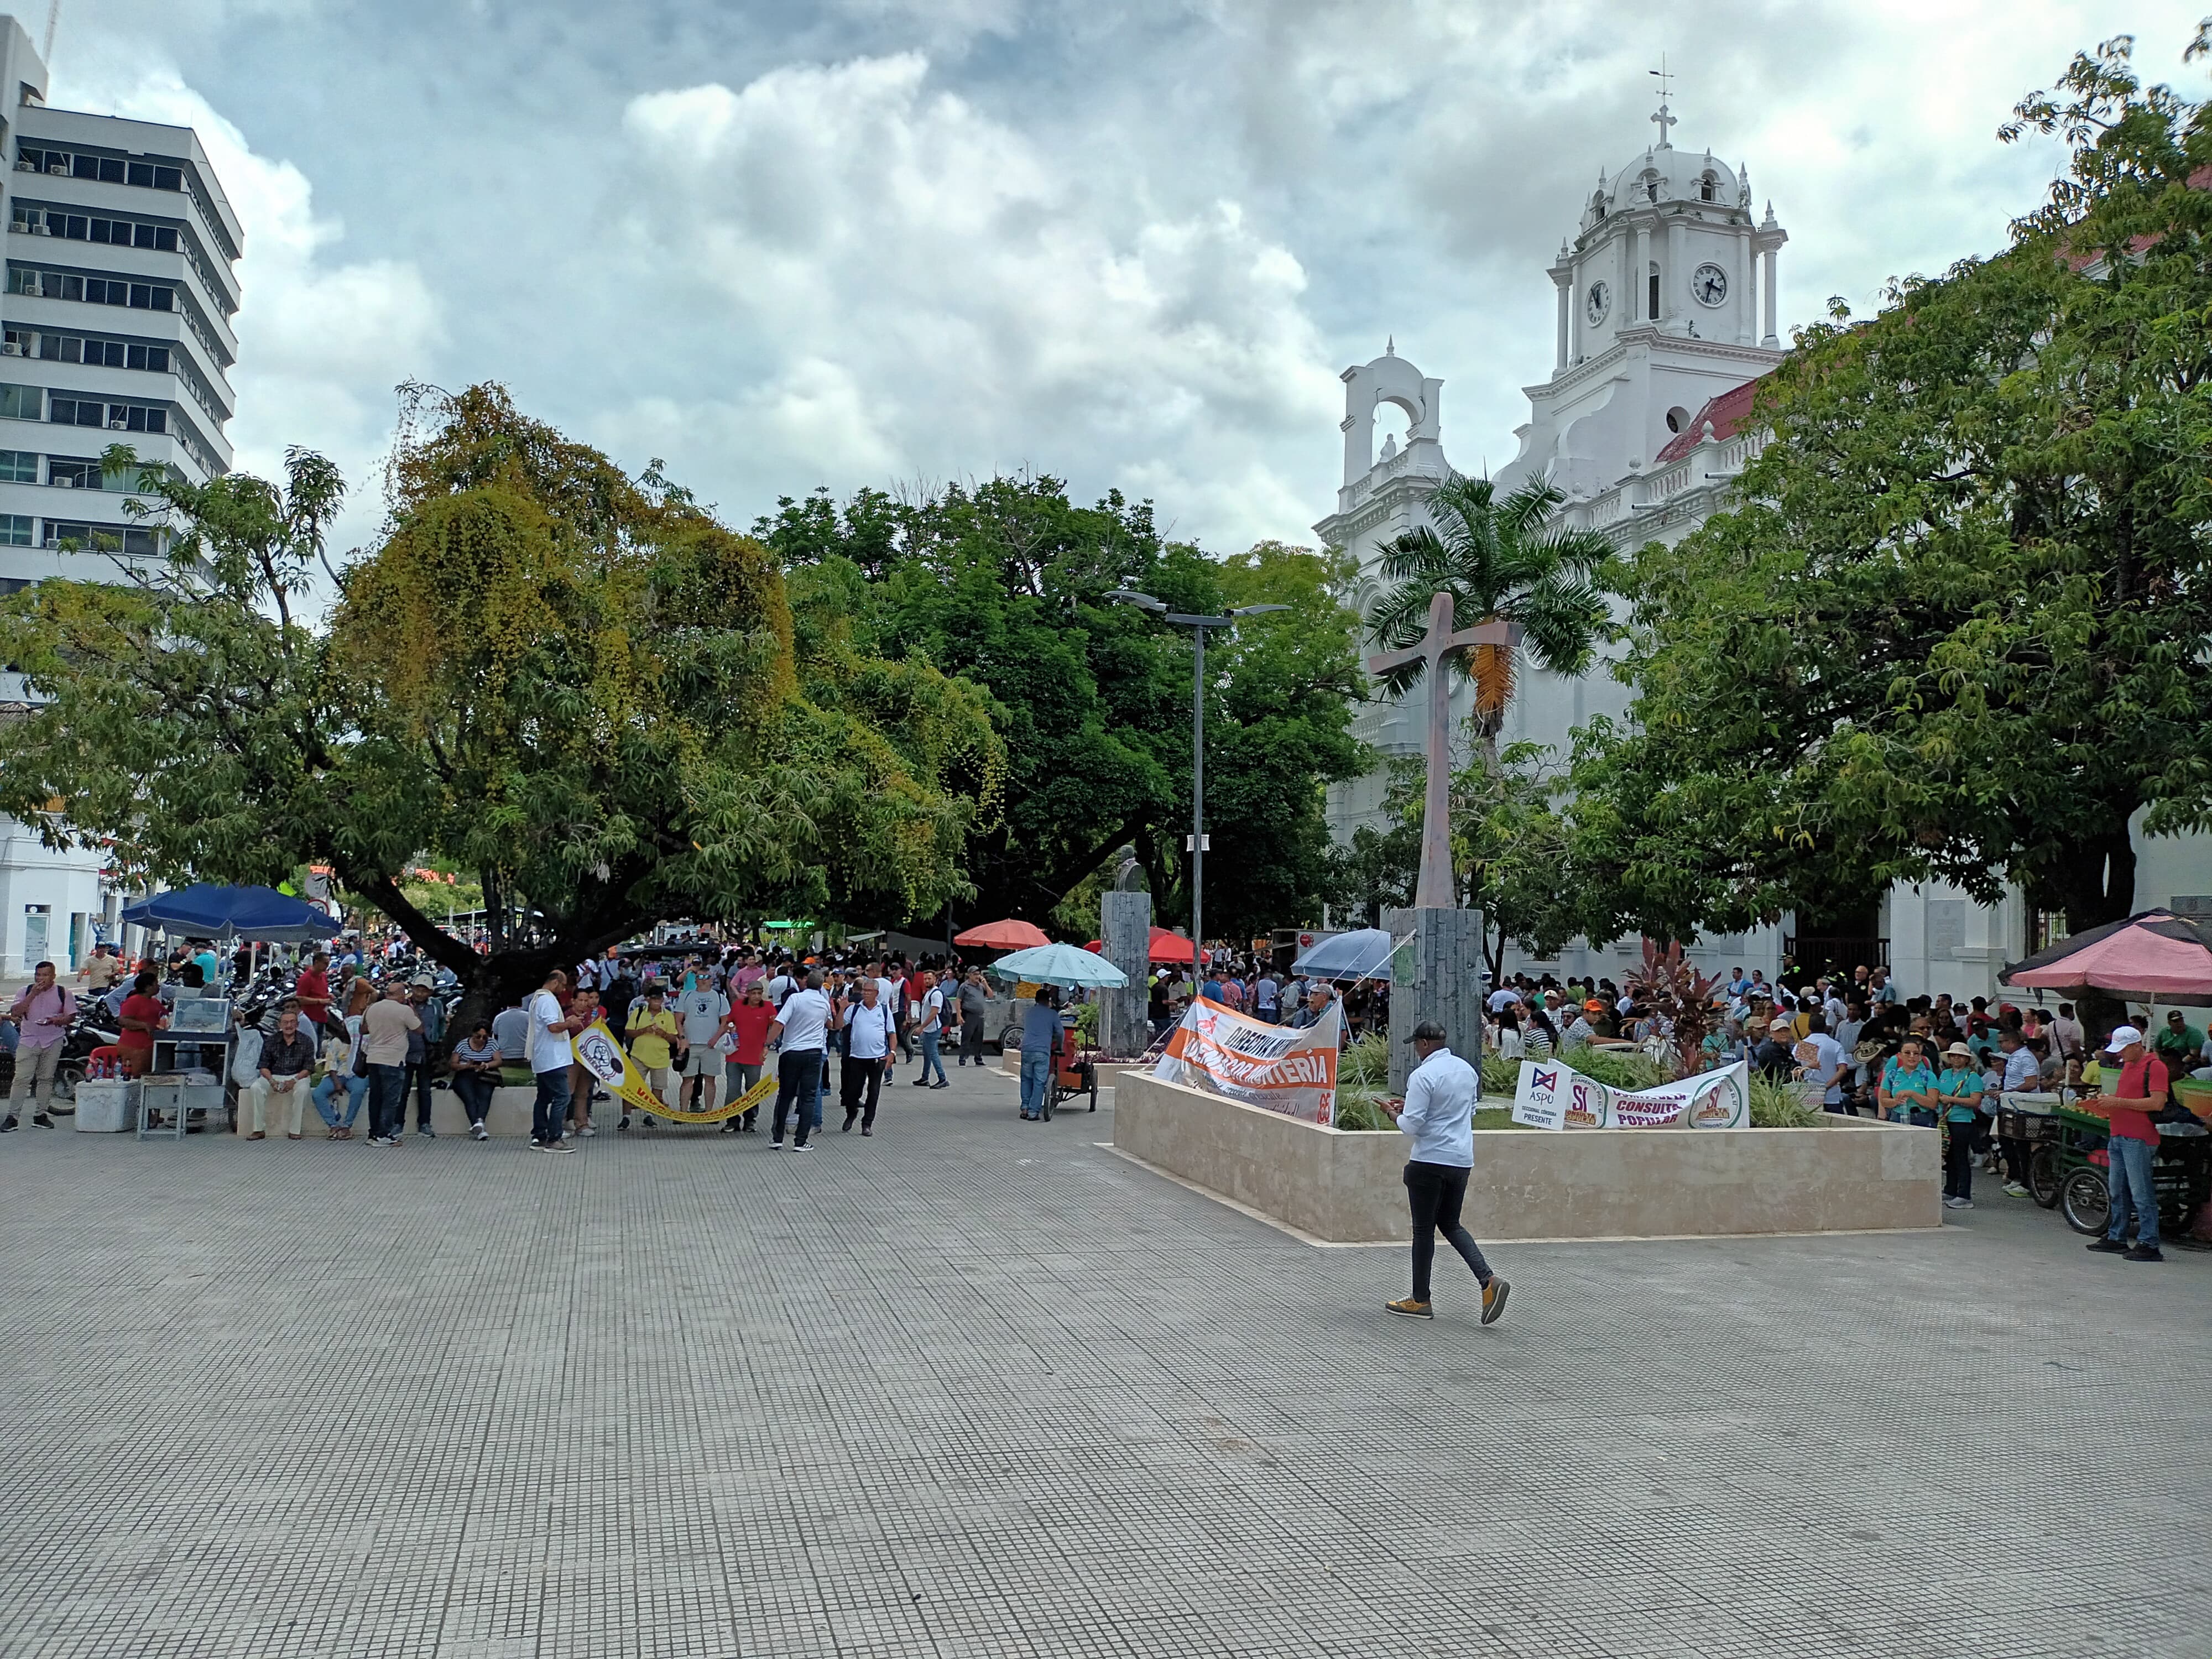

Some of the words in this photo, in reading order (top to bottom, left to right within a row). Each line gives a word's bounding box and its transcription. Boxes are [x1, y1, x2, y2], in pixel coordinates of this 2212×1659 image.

[1224, 1026, 1278, 1057] DIRECTIVA
[1529, 1091, 1554, 1105] ASPU
[1572, 1084, 1589, 1112] SÍ
[1616, 1100, 1683, 1114] CONSULTA
[1524, 1113, 1553, 1125] PRESENTE
[1566, 1110, 1595, 1118] ONSULTA
[1566, 1115, 1596, 1125] OPULAR
[1618, 1114, 1678, 1126] POPULAR
